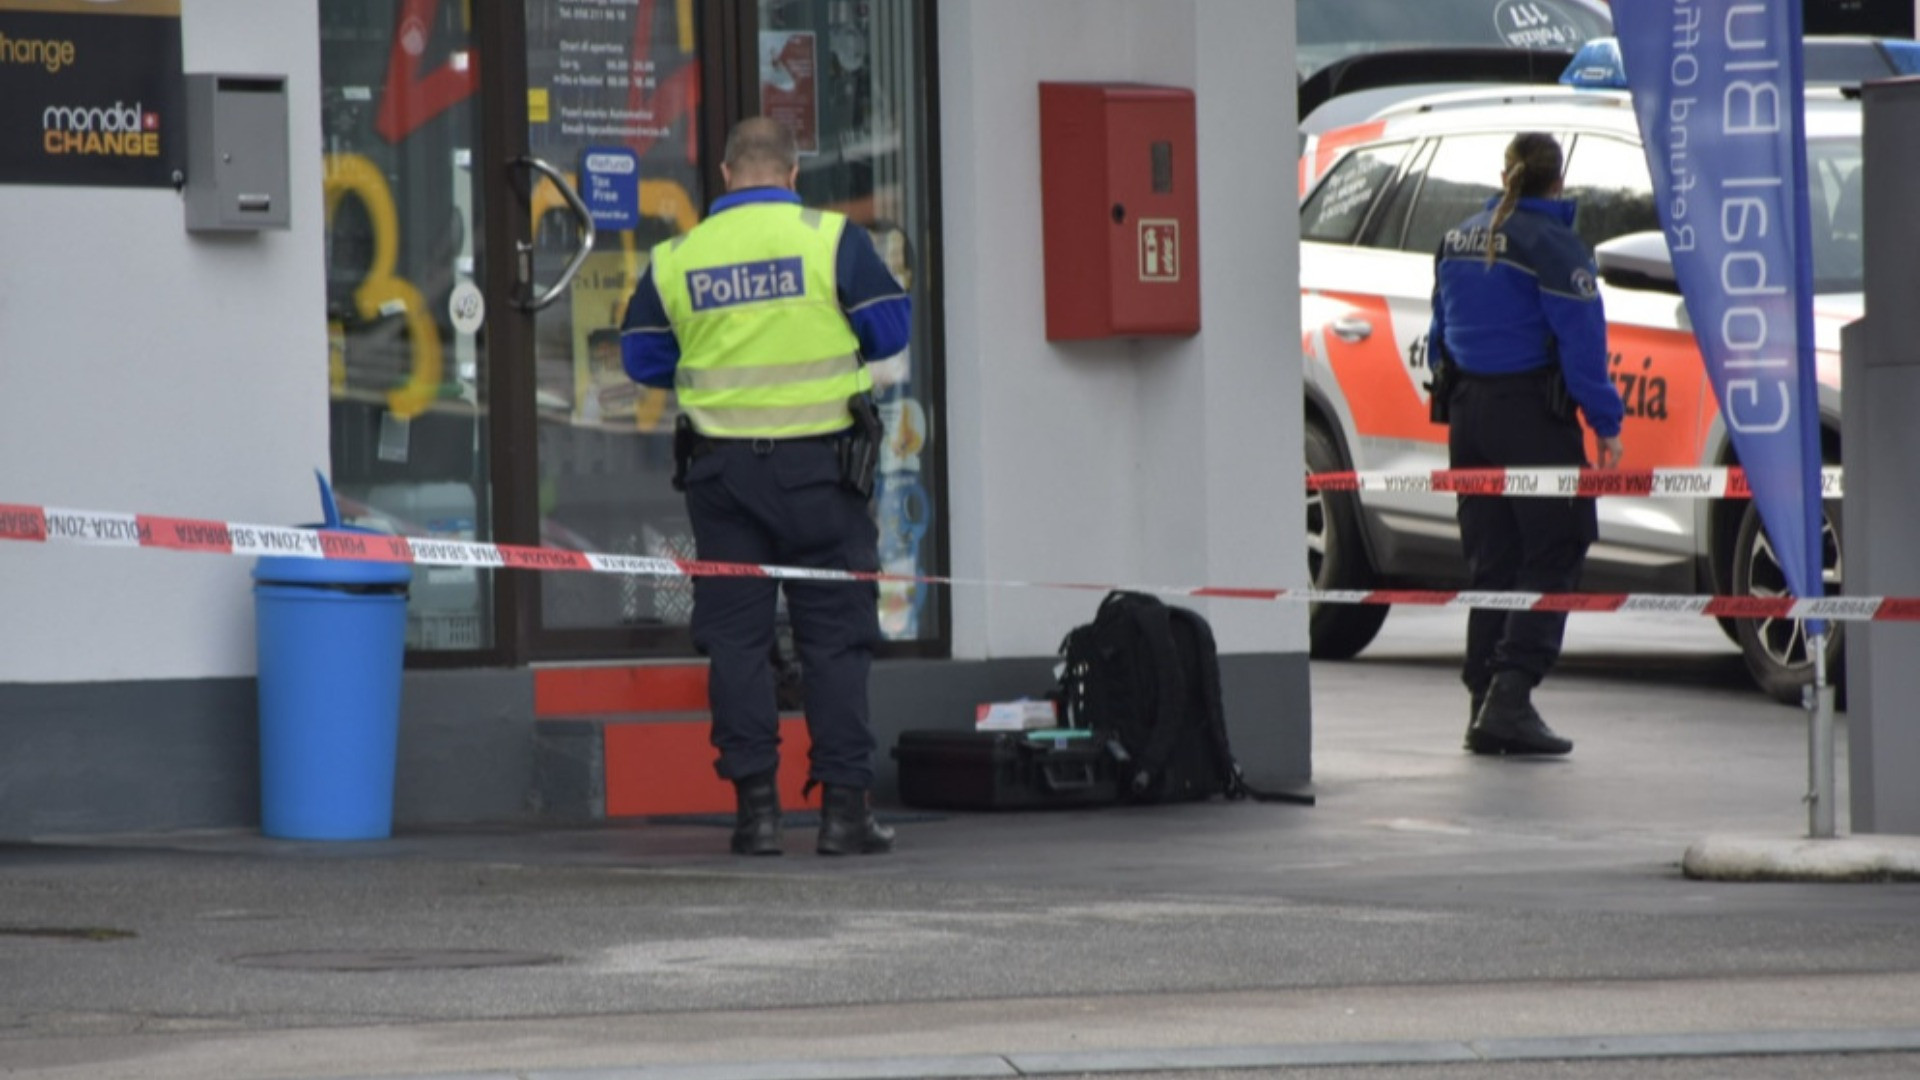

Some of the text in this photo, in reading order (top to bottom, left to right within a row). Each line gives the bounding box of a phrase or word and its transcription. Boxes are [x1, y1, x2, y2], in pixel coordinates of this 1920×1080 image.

[43, 101, 142, 131] mondial
[43, 131, 160, 156] CHANGE
[1445, 225, 1507, 253] Poliza
[691, 263, 798, 307] Polizia
